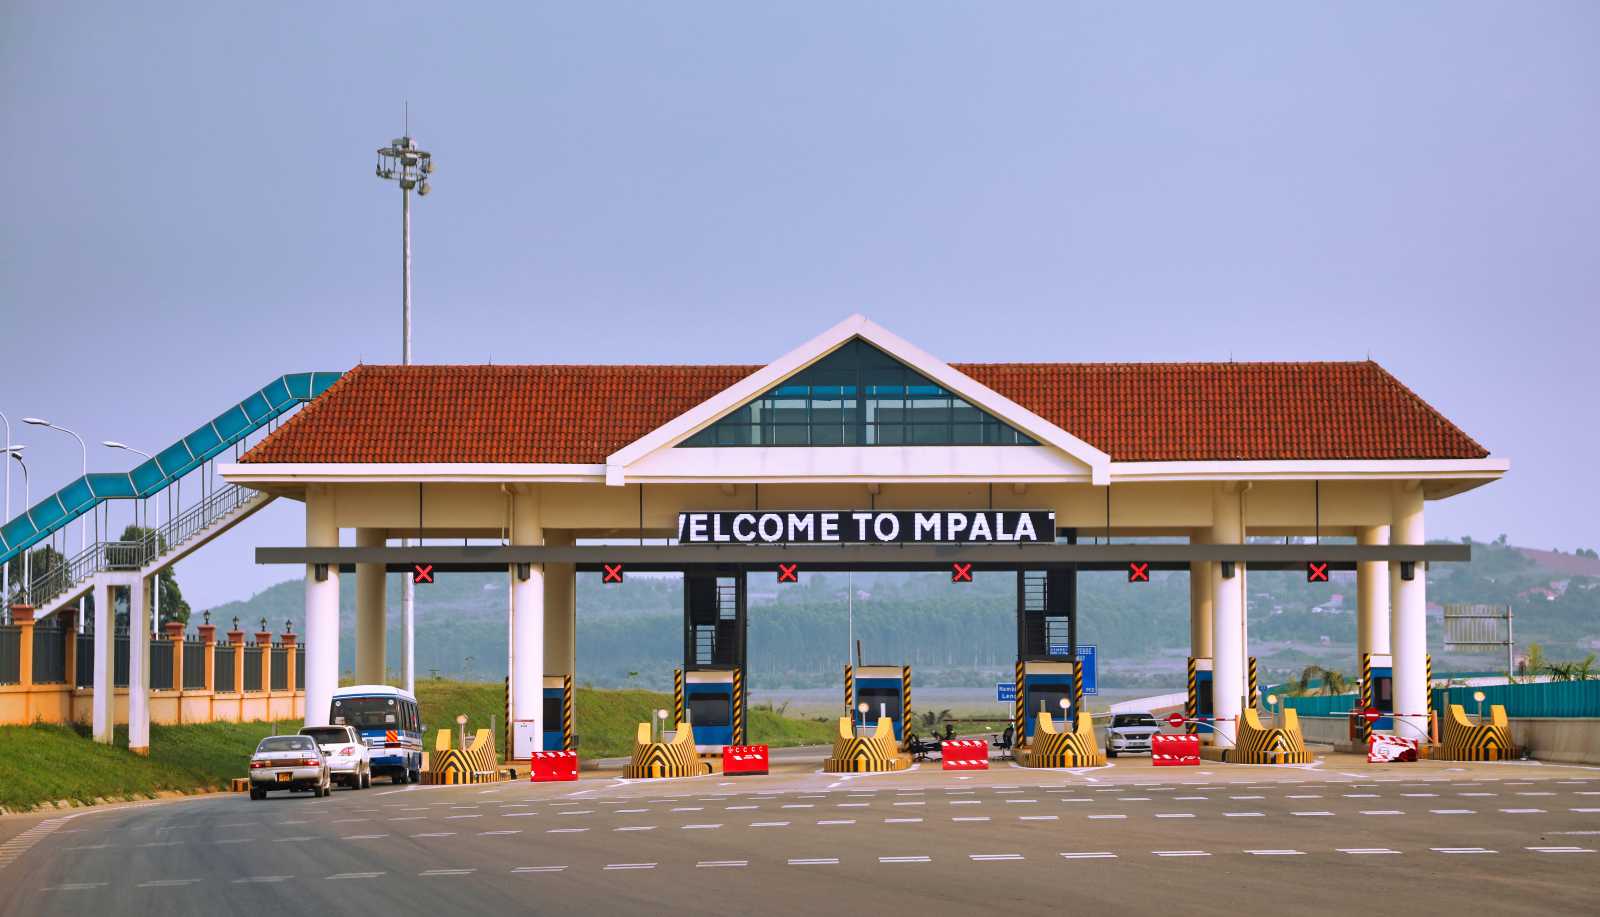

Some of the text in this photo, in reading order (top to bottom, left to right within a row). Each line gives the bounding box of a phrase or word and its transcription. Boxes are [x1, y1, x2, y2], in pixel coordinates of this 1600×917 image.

[679, 512, 1037, 542] ELCOME TO MPALA
